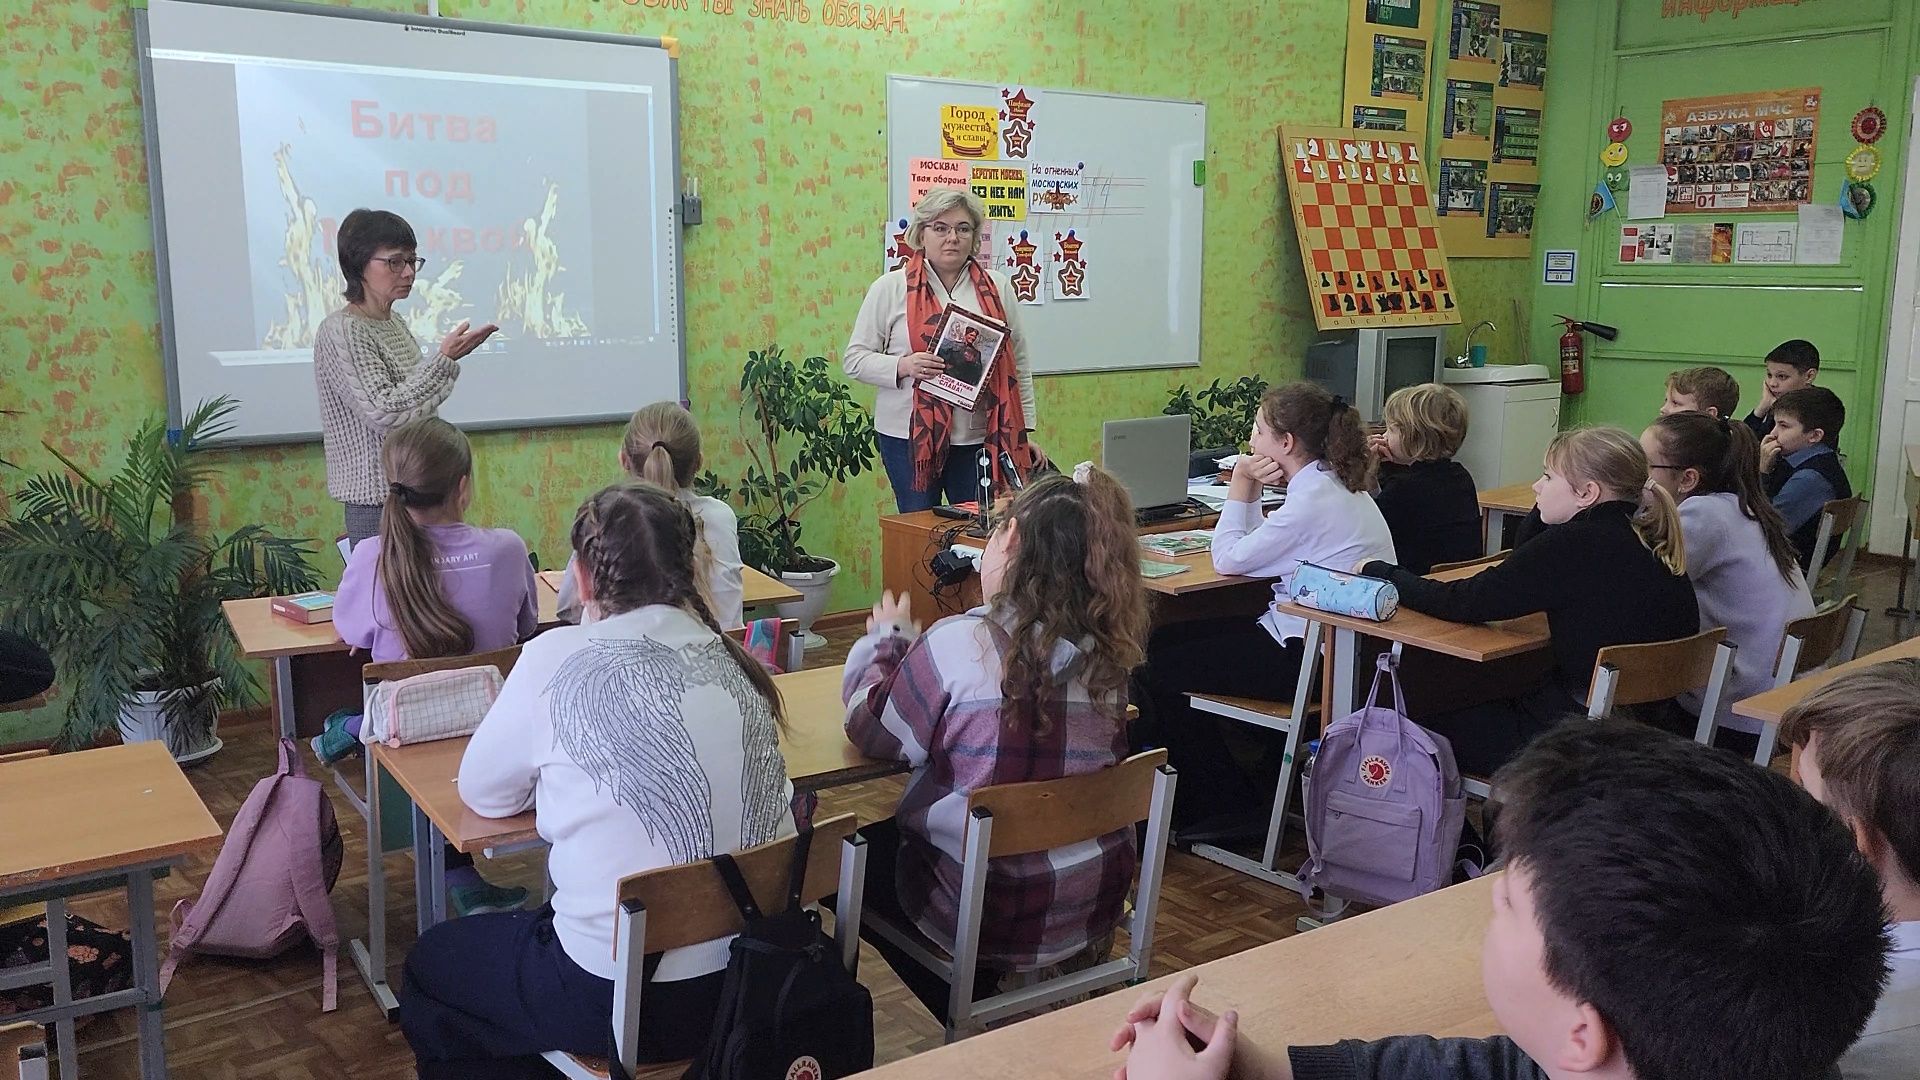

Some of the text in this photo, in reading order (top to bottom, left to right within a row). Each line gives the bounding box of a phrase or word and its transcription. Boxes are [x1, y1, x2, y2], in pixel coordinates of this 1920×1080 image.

[748, 0, 811, 23] ЗНАТЬ
[822, 0, 908, 33] ОБЯЗАН.
[950, 105, 986, 122] Город
[1686, 103, 1793, 123] АЗБУКА МЧС
[350, 99, 497, 143] Битва
[943, 122, 991, 133] мужества
[963, 134, 986, 142] славы
[920, 161, 959, 171] МОСКВА!
[1031, 163, 1079, 177] На огненных
[912, 173, 967, 186] Твоя оборона
[384, 169, 475, 204] под
[990, 186, 1005, 199] НЕЕ
[1008, 186, 1025, 199] НАМ
[1697, 194, 1717, 208] 01
[989, 204, 1015, 217] ЖИТЬ!
[463, 552, 479, 561] ART
